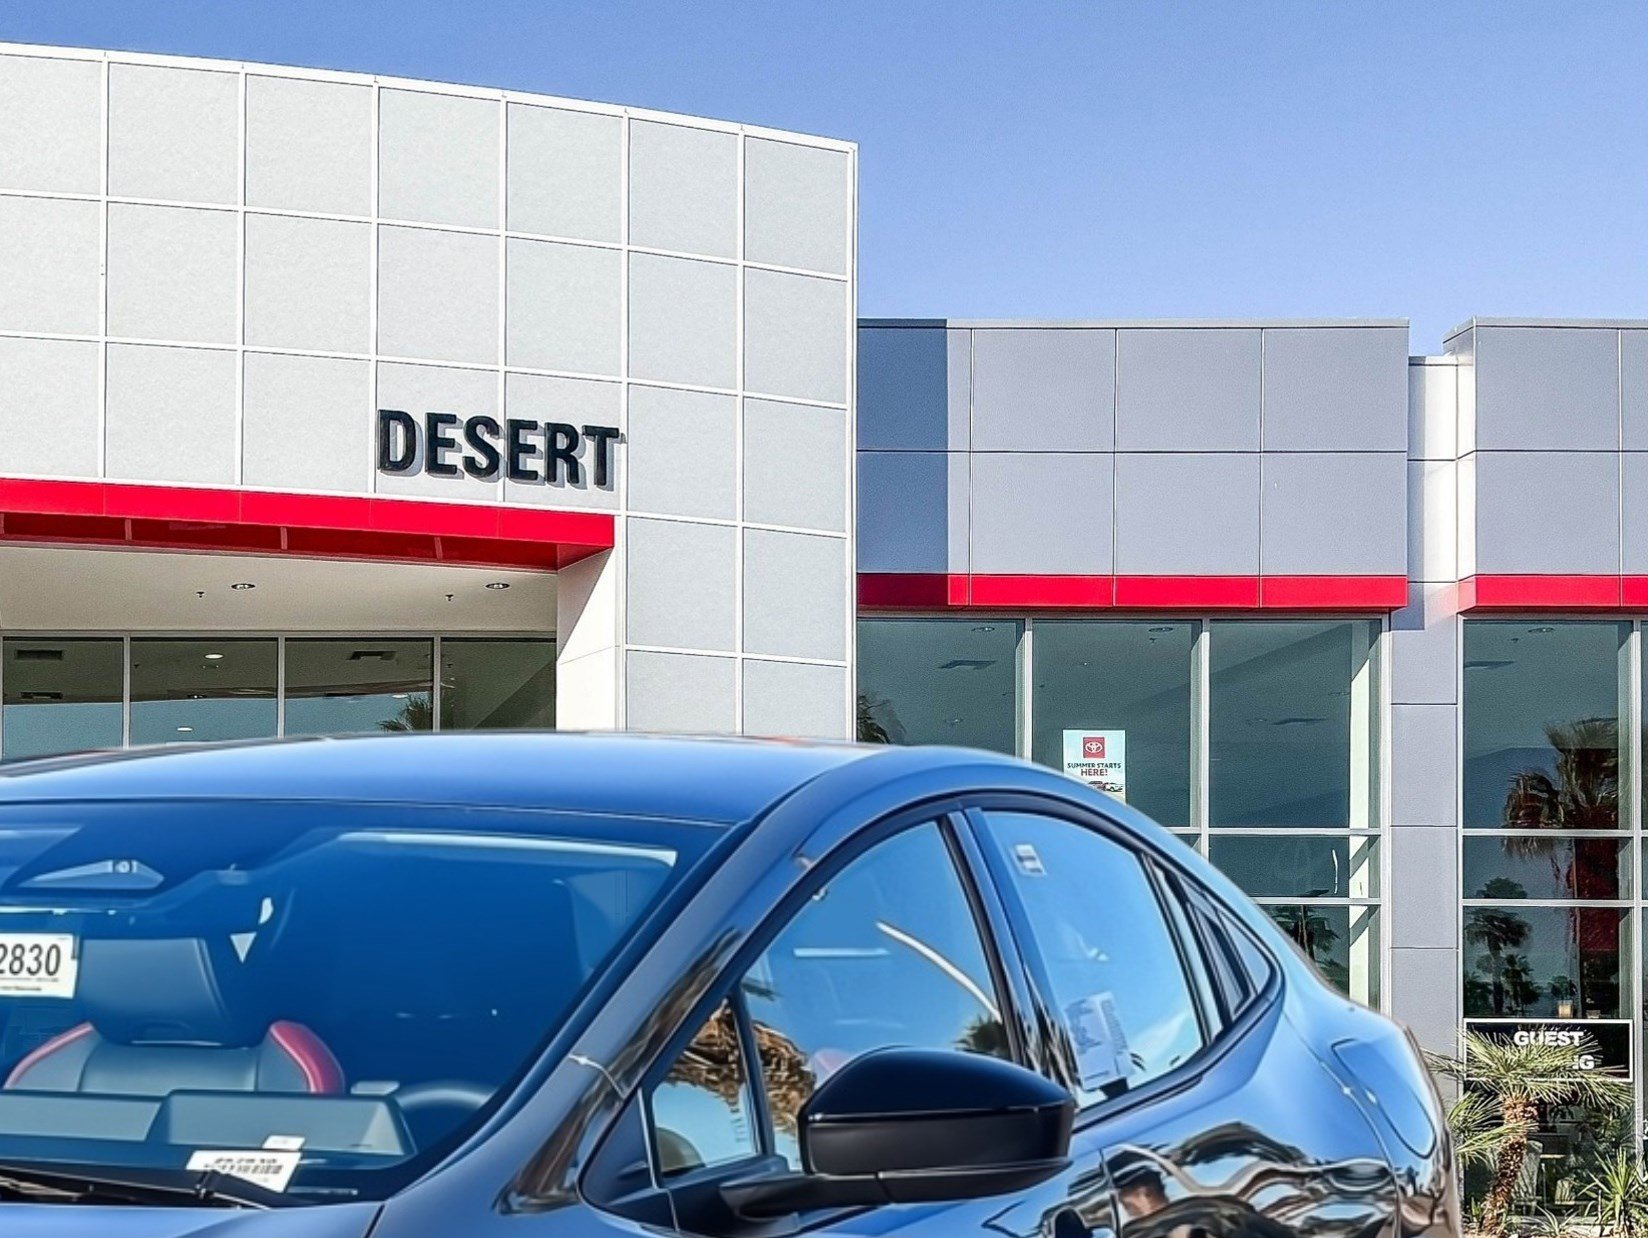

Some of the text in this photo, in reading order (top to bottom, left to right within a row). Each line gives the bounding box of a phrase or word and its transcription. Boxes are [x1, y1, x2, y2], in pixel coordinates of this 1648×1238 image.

[376, 408, 621, 487] DESERT
[1081, 768, 1108, 777] HERE!
[1513, 1030, 1584, 1047] GUEST
